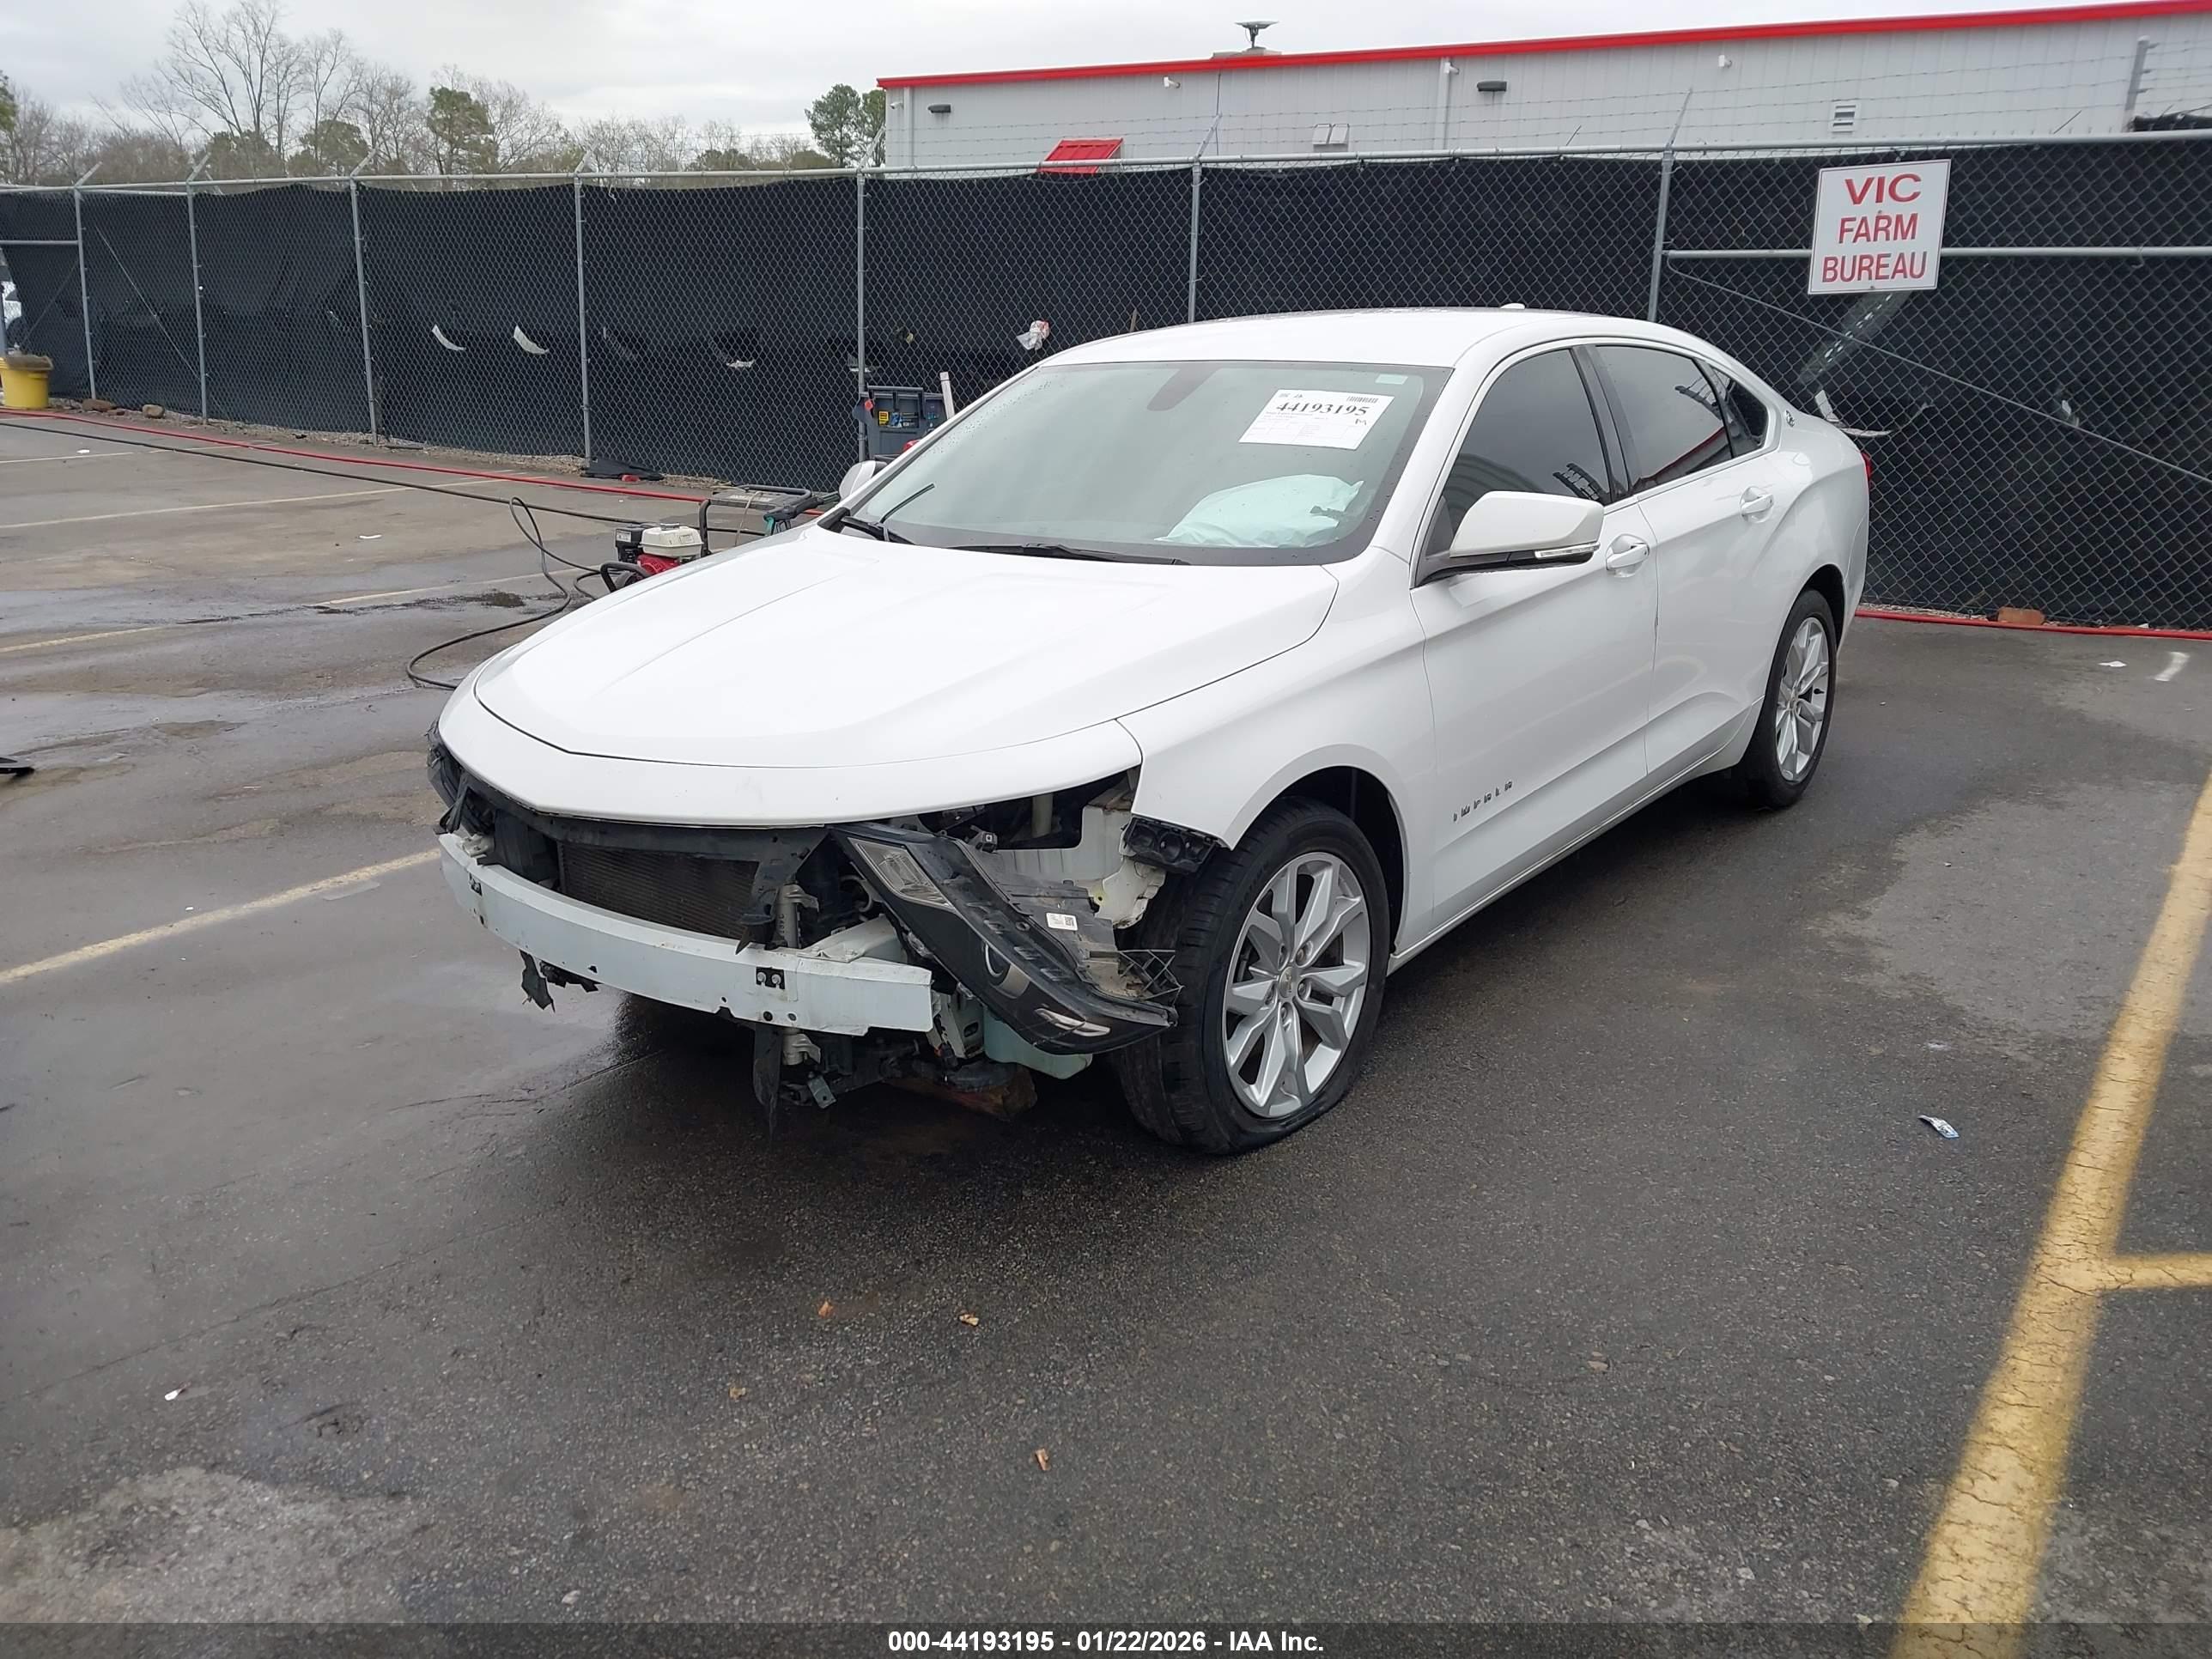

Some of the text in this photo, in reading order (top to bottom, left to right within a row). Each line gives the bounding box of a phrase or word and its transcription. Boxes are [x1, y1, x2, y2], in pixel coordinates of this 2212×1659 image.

[1844, 173, 1922, 205] VIC
[1838, 213, 1918, 244] FARM
[1821, 251, 1928, 283] BUREAU
[1276, 402, 1370, 416] 44193195
